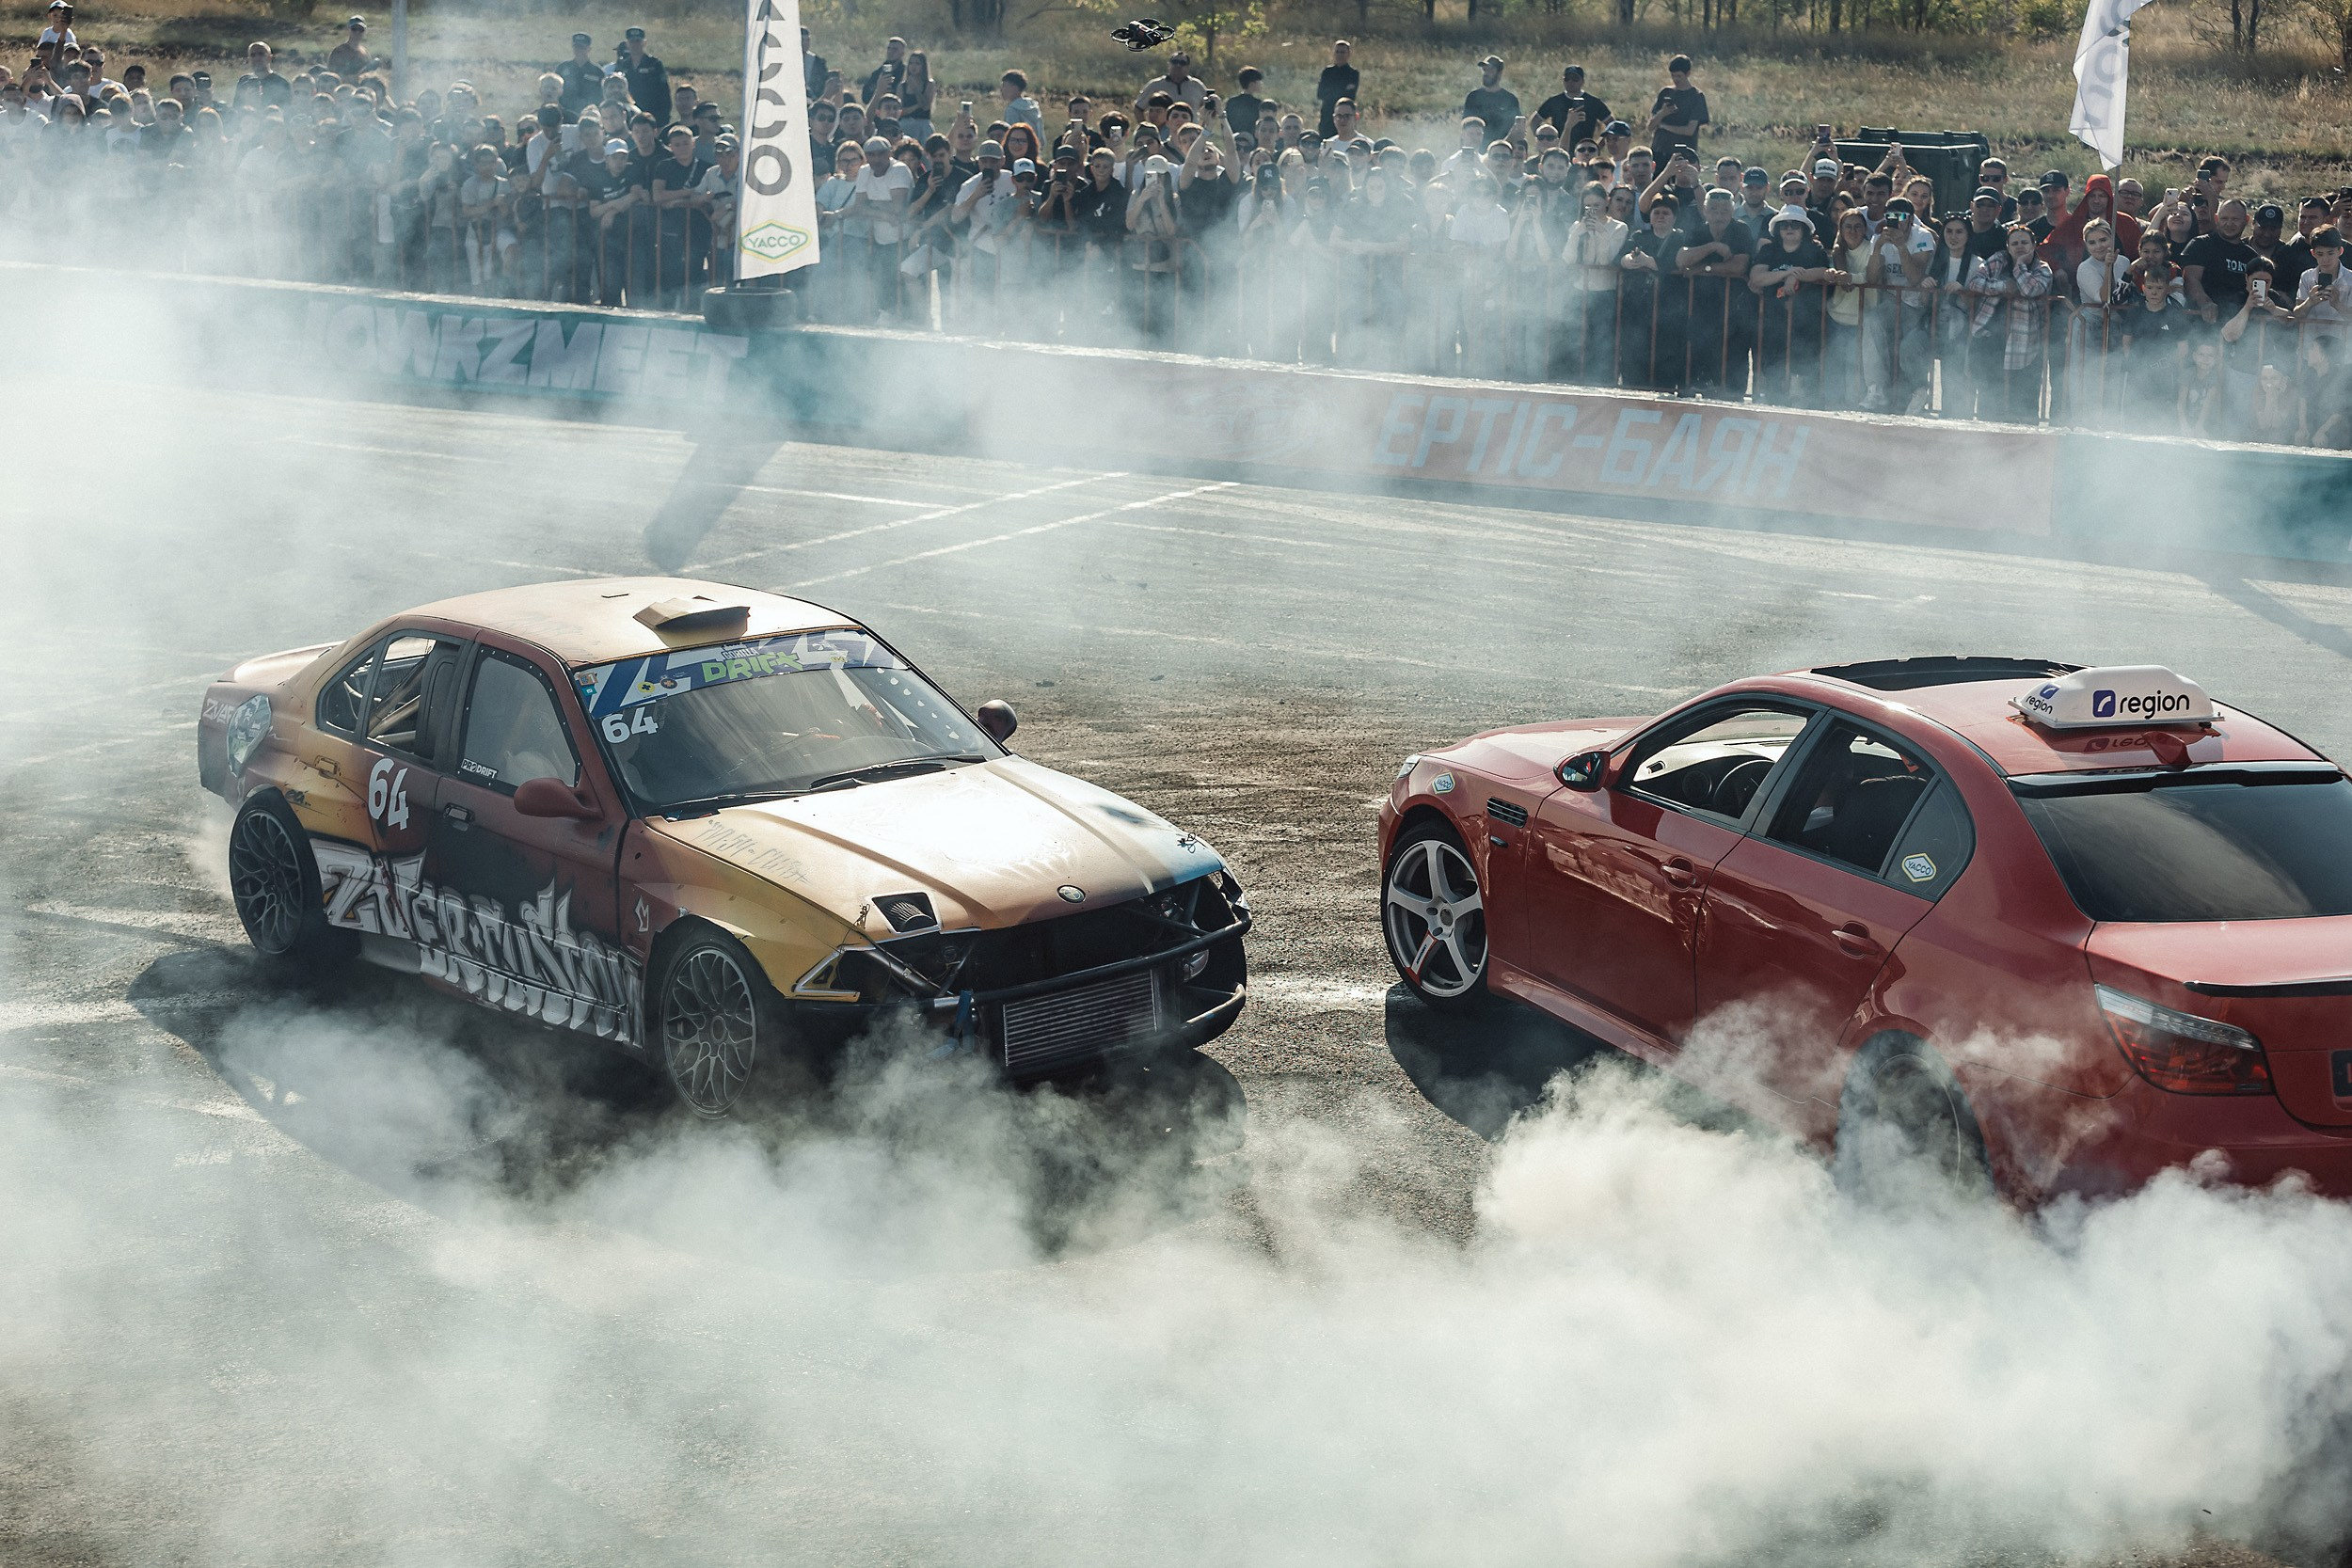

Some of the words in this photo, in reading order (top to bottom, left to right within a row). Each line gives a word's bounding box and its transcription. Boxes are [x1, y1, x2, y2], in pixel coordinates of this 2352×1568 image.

[749, 235, 801, 248] YACCO
[723, 647, 759, 660] GORILLA
[2026, 695, 2053, 714] region
[2120, 689, 2190, 720] region
[601, 707, 658, 744] 64
[368, 758, 409, 831] 64
[1908, 861, 1931, 875] YACCO
